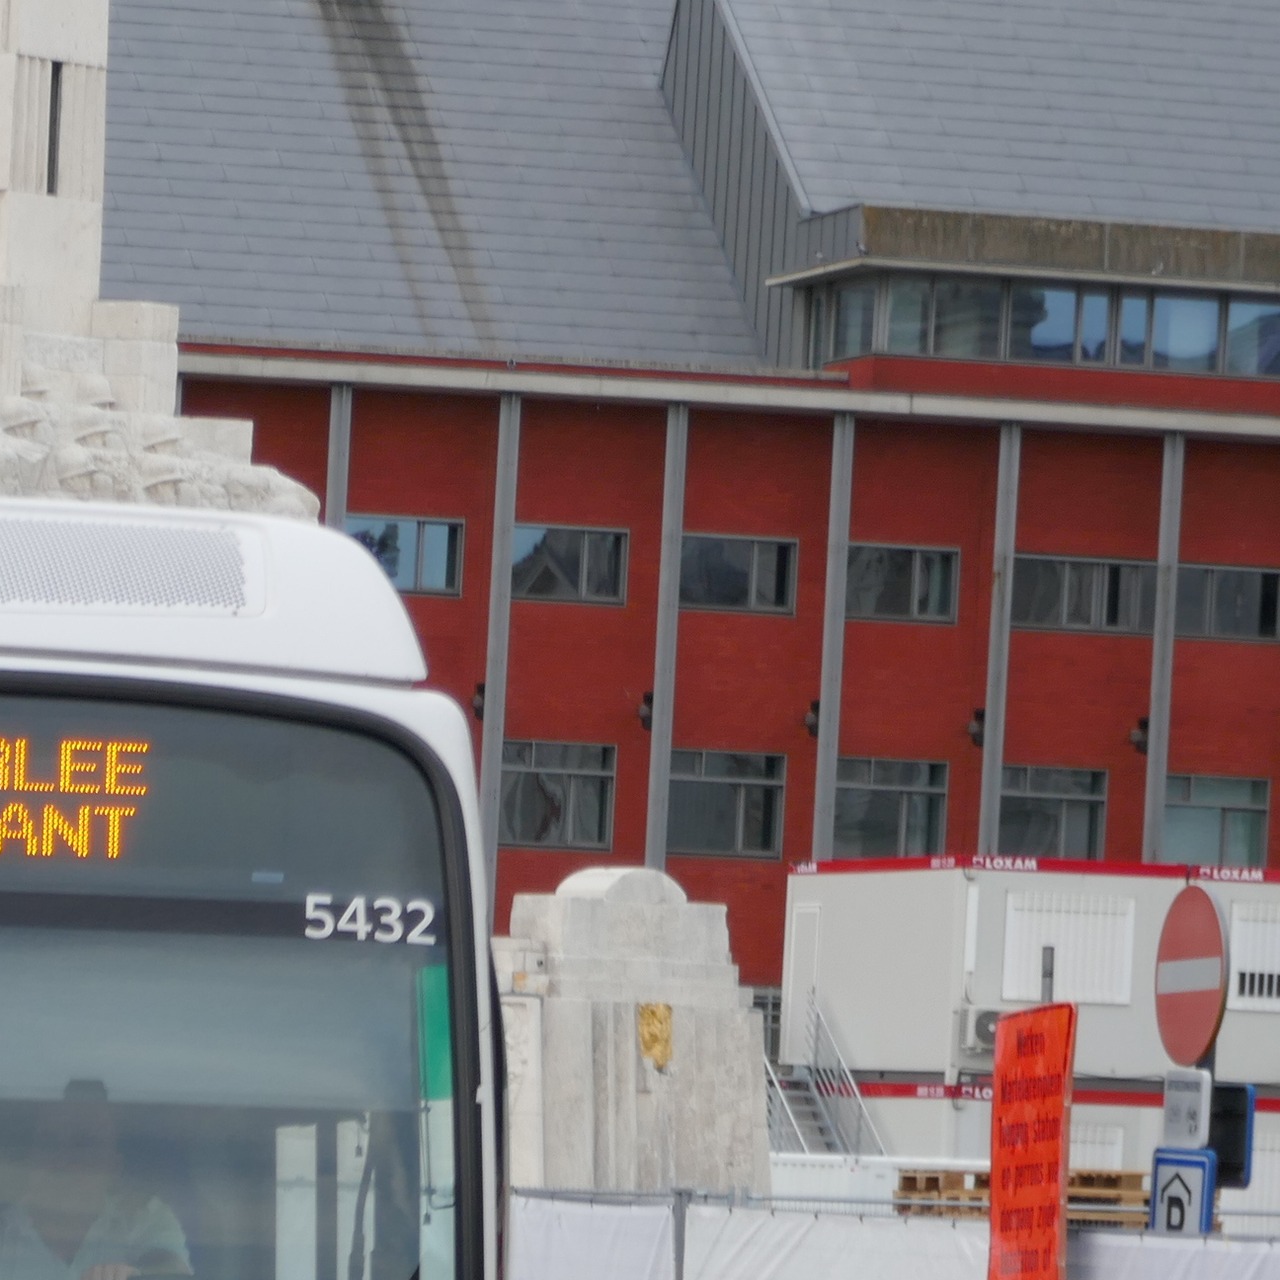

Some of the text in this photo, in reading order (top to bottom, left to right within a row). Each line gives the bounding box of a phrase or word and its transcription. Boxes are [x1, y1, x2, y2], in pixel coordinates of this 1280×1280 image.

[985, 857, 1037, 870] LOXAM
[1213, 868, 1264, 881] LOXAM
[304, 894, 436, 946] 5432
